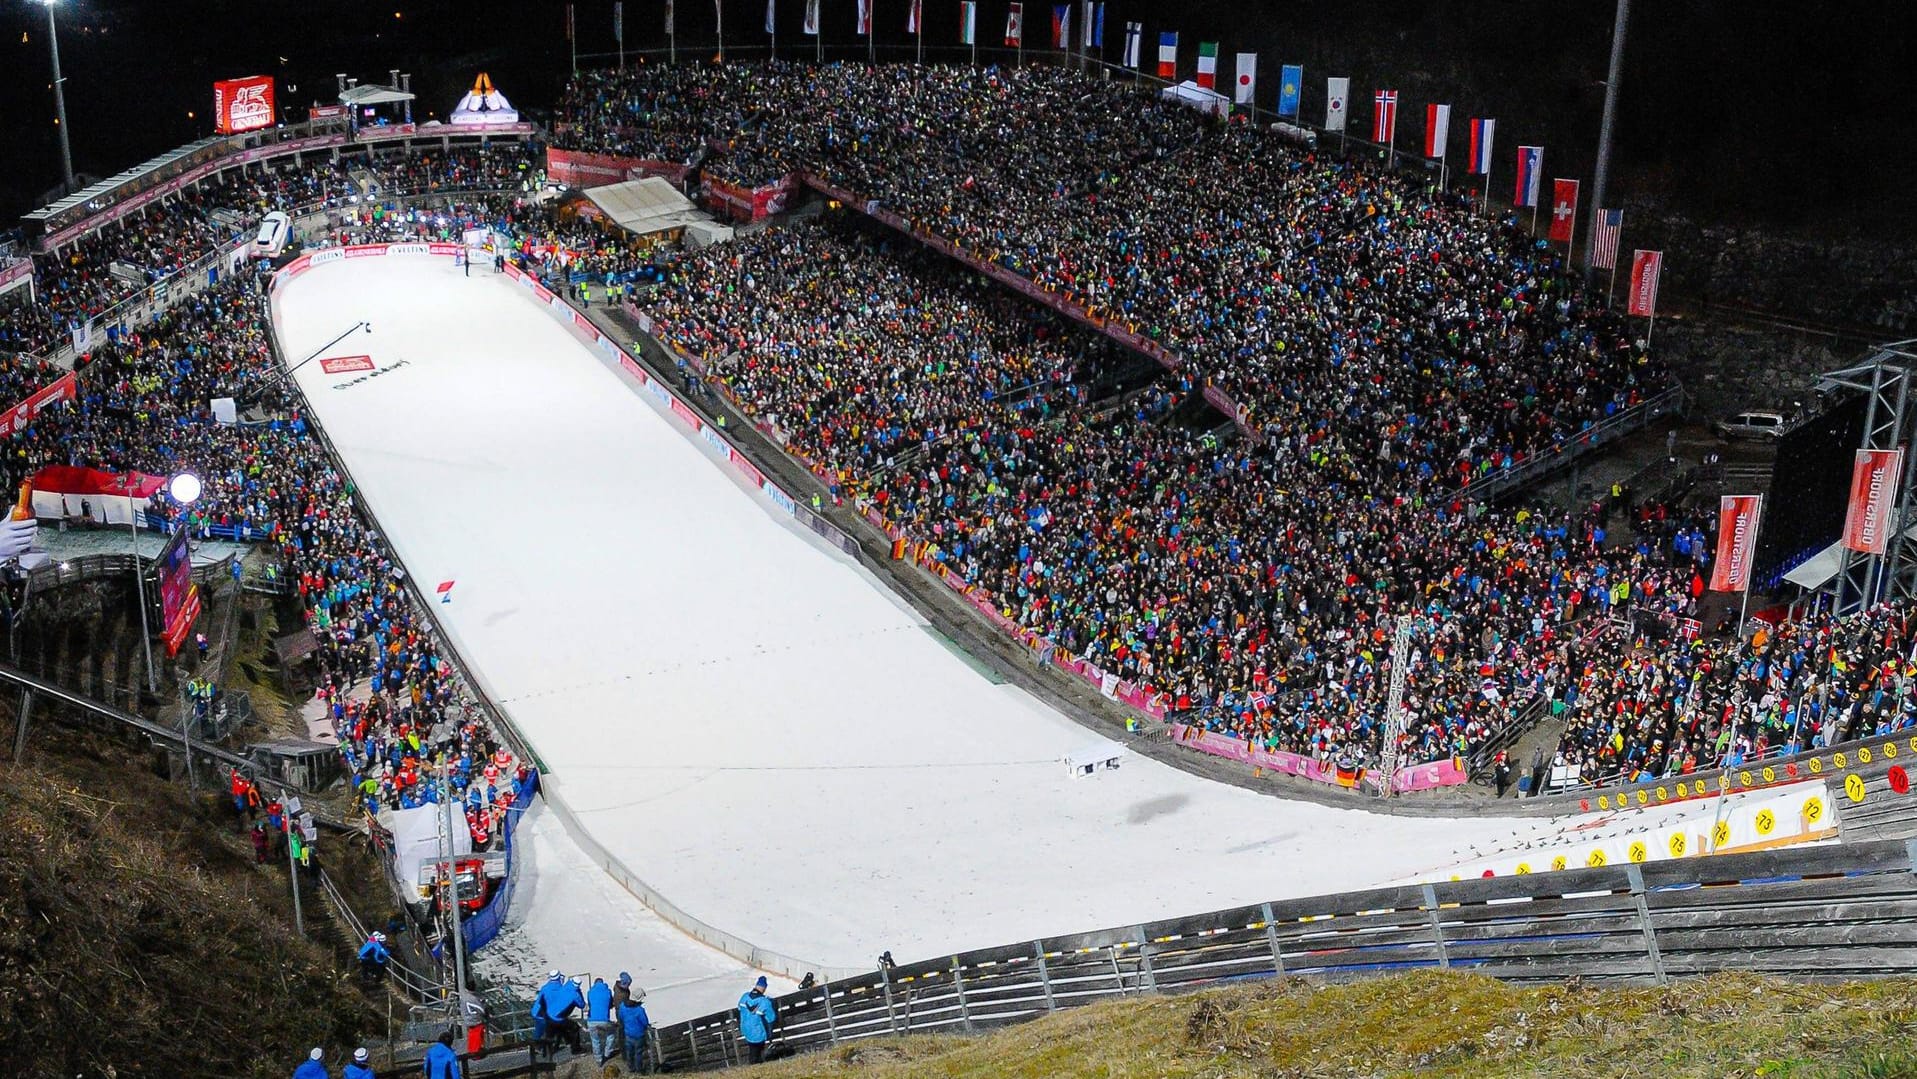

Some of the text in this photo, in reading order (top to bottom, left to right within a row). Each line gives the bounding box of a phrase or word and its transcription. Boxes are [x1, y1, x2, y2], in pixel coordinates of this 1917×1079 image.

[1859, 749, 1871, 762] 127
[1850, 778, 1861, 798] 71
[1893, 770, 1906, 790] 70
[1806, 802, 1820, 819] 72
[1759, 814, 1772, 830] 73
[1672, 836, 1685, 853] 75
[1592, 853, 1604, 867] 77
[1632, 846, 1644, 862] 76
